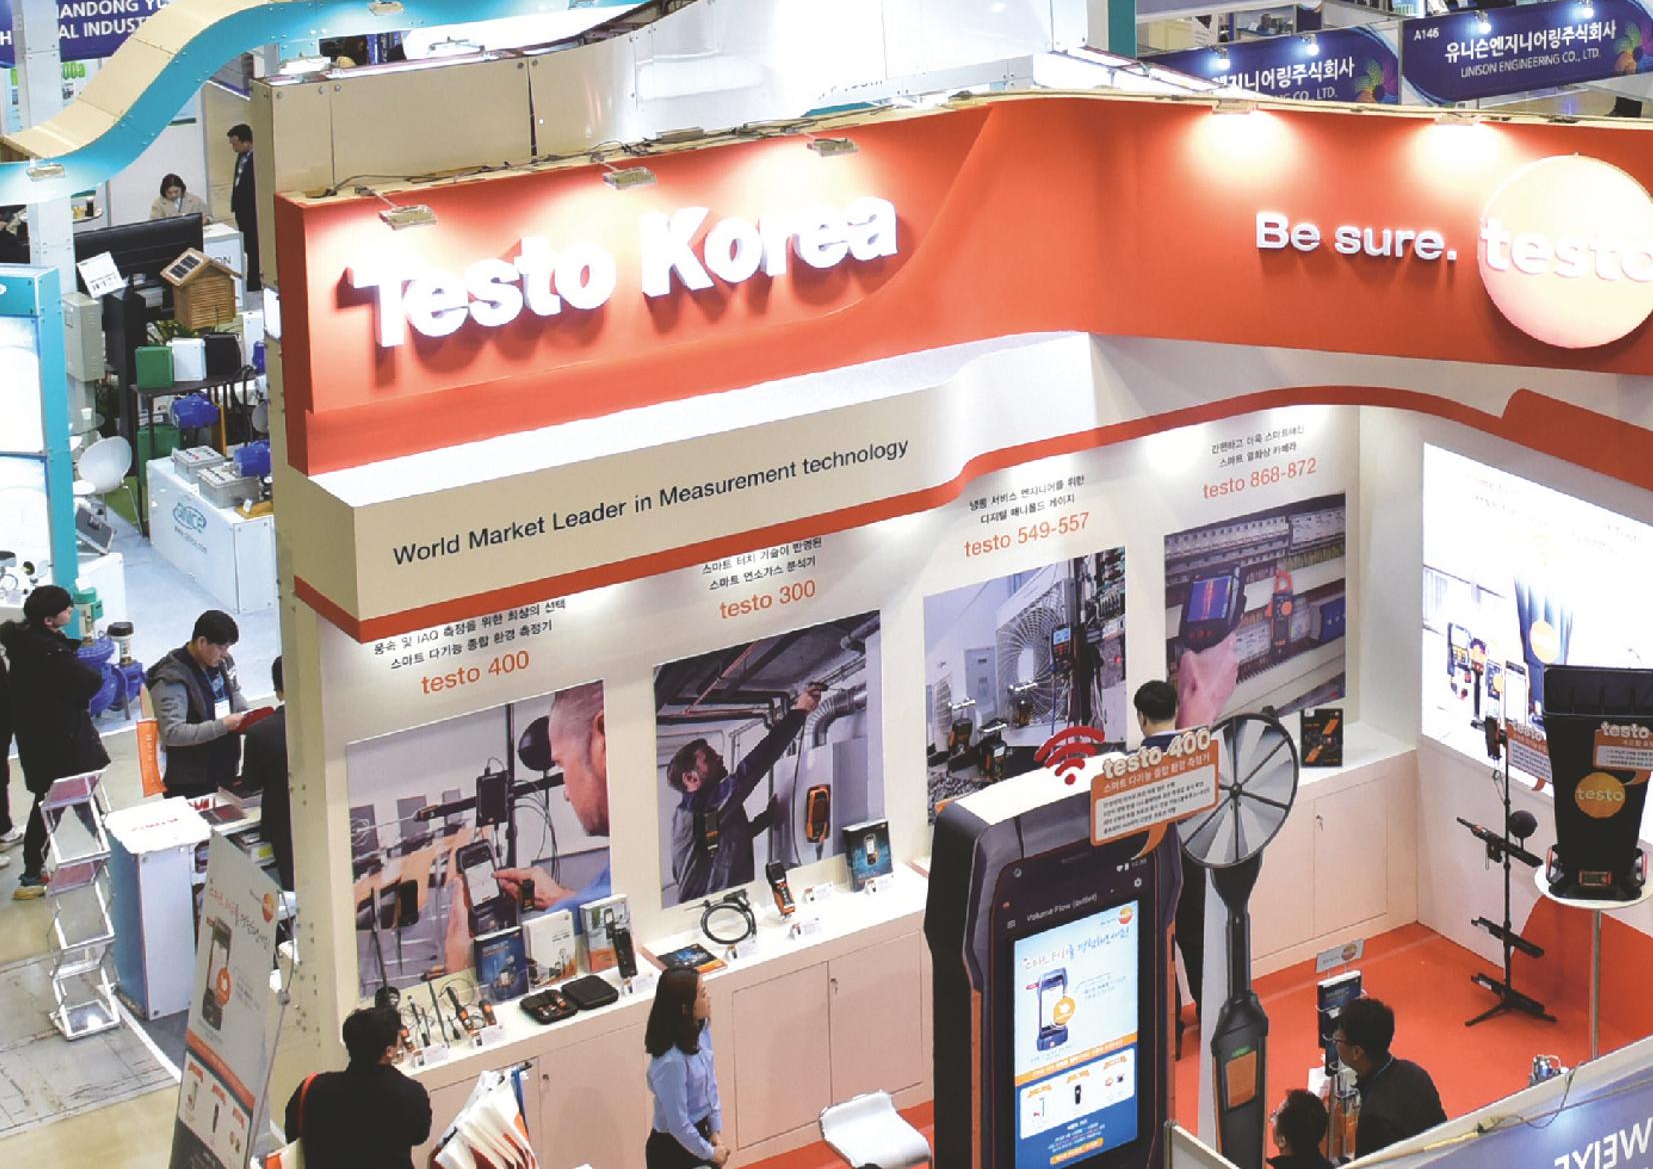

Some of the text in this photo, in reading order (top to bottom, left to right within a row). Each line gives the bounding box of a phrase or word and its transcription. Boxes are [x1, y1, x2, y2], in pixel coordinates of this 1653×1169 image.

[1445, 20, 1616, 63] 유니슨엔지니어링주식회사
[1461, 63, 1498, 78] UNISON
[1500, 54, 1560, 72] ENGINEERING
[1255, 211, 1457, 261] Be sure.
[1480, 217, 1653, 282] testo
[352, 195, 898, 348] Testo Korea
[991, 492, 1017, 505] 서비스
[1203, 457, 1317, 499] testo 868-872
[393, 439, 909, 566] World Market Leader in Measurement technology
[980, 509, 1007, 524] 디지털
[964, 511, 1089, 557] testo 549-557
[702, 559, 732, 574] 스마트
[760, 545, 790, 560] 기술이
[709, 555, 816, 590] 스마트 연소가스 분석기
[720, 579, 816, 619] testo 300
[417, 631, 438, 644] IAQ
[443, 621, 477, 637] 측정을
[481, 613, 503, 628] 위한
[508, 605, 540, 621] 최상의
[545, 599, 566, 614] 선택
[391, 620, 552, 670] 스마트 다기능 종합 환경 측정기
[421, 650, 530, 694] testo 400
[1601, 721, 1650, 739] testo
[1103, 728, 1210, 779] testo 400
[1577, 785, 1625, 801] testo
